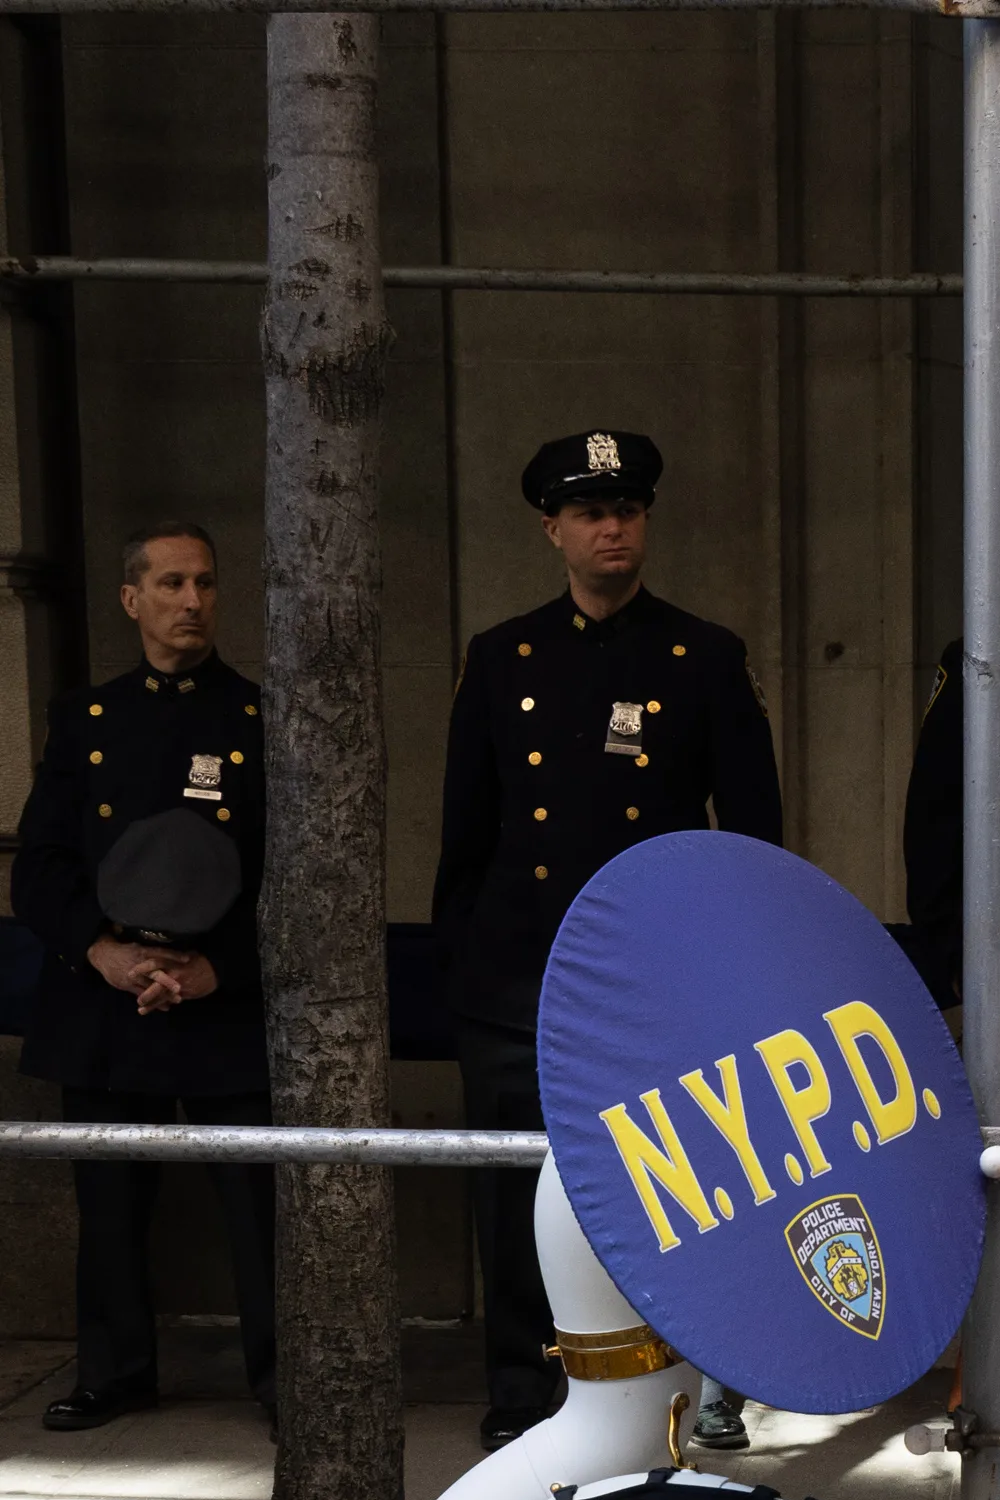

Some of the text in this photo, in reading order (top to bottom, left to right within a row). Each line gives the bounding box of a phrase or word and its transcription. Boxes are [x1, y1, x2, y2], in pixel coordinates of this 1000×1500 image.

[599, 1001, 942, 1254] N.Y.P.D.
[797, 1217, 868, 1266] DEPARTMENT
[801, 1201, 845, 1234] POLICE
[810, 1240, 883, 1322] CITY OF NEW YORK
